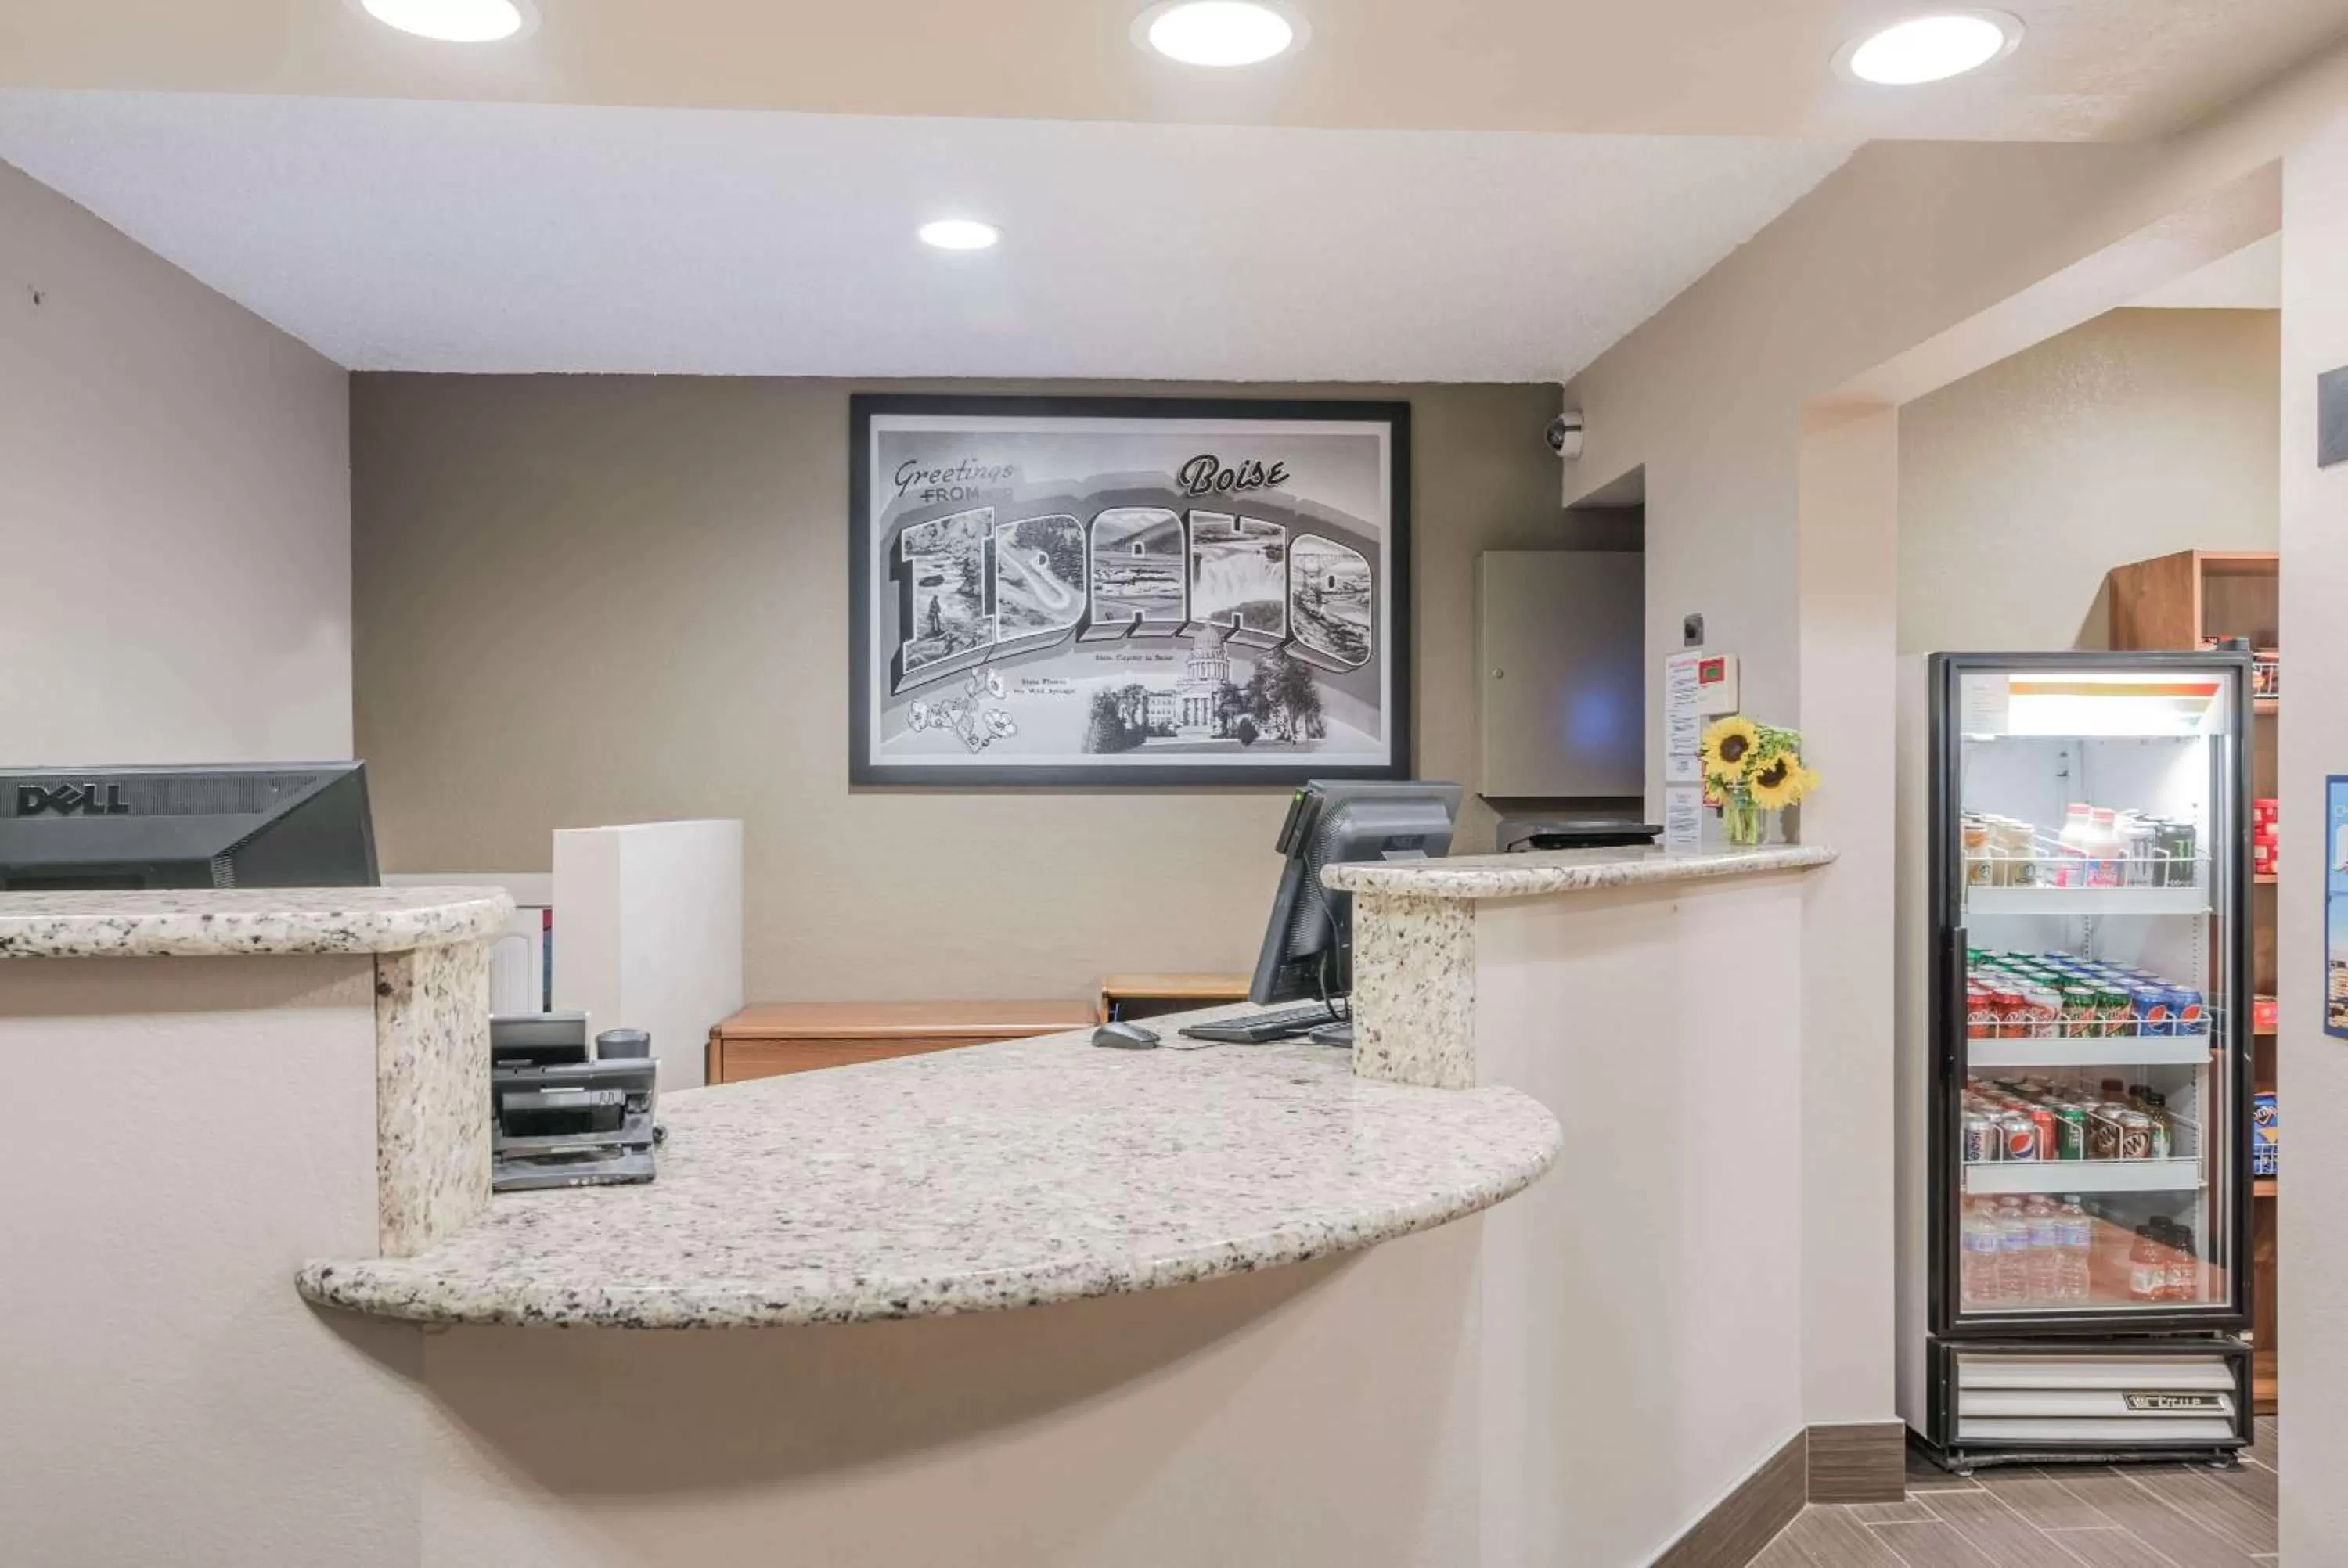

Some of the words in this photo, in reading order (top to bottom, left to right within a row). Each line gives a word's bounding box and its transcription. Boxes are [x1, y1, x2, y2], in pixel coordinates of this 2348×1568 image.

[895, 457, 1014, 498] Greetings
[1179, 454, 1291, 494] Boise
[920, 486, 979, 503] FROM
[891, 506, 1372, 695] IDAHO
[17, 783, 131, 816] DELL
